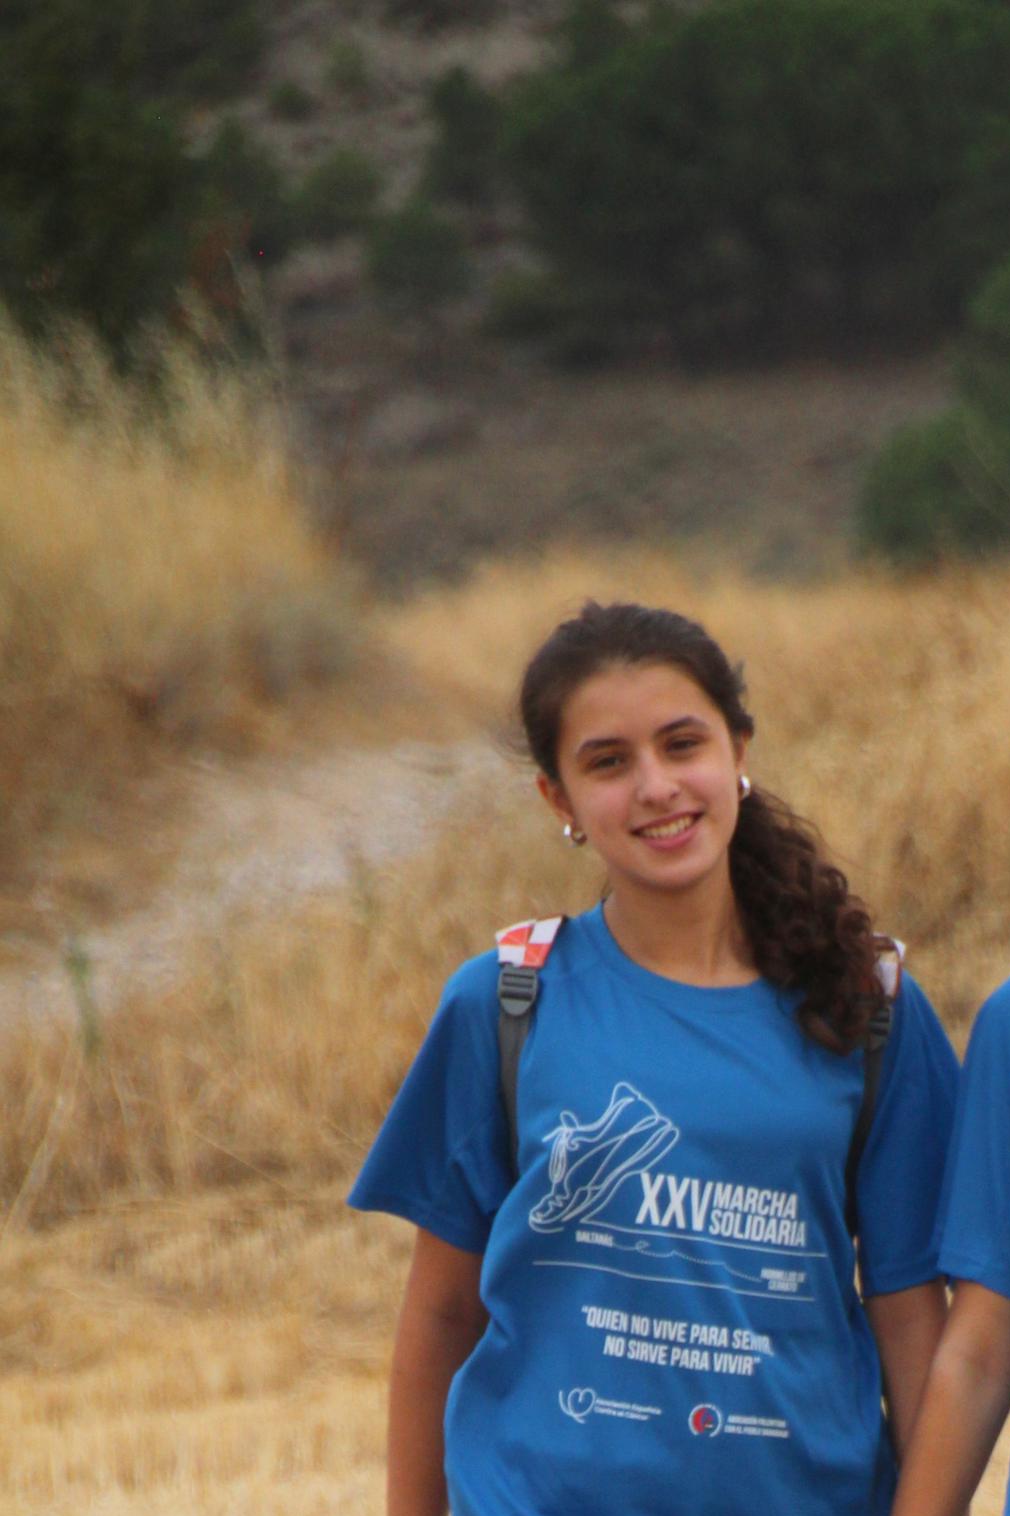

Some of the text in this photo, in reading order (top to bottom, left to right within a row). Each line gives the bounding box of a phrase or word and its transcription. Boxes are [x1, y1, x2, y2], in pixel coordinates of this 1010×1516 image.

[635, 1172, 798, 1231] XXV MARCHA
[708, 1209, 806, 1247] SOLIDARIA
[581, 1305, 628, 1333] "QUIEN
[630, 1314, 649, 1337] NO
[653, 1319, 687, 1343] VIVE
[690, 1324, 729, 1349] PARA
[603, 1336, 761, 1377] NO SIRVE PARA VIVIR"
